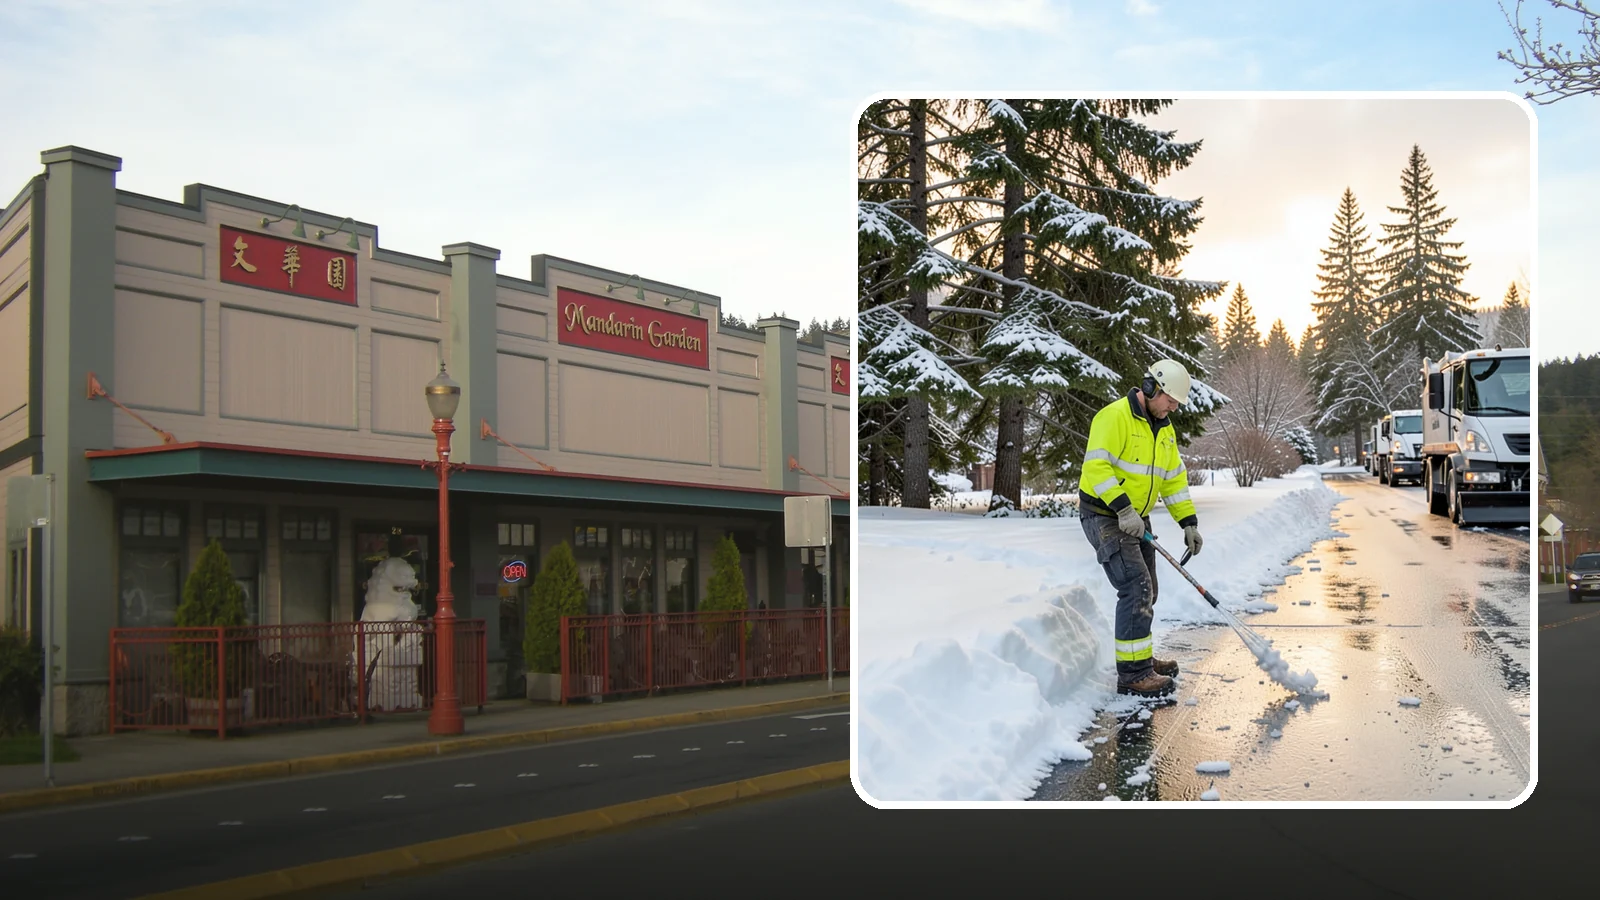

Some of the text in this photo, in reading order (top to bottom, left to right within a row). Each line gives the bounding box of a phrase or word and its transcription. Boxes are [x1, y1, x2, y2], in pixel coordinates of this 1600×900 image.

[231, 235, 346, 290] 文華園
[564, 302, 701, 352] Mandarin Garden
[503, 565, 527, 578] OPEN
